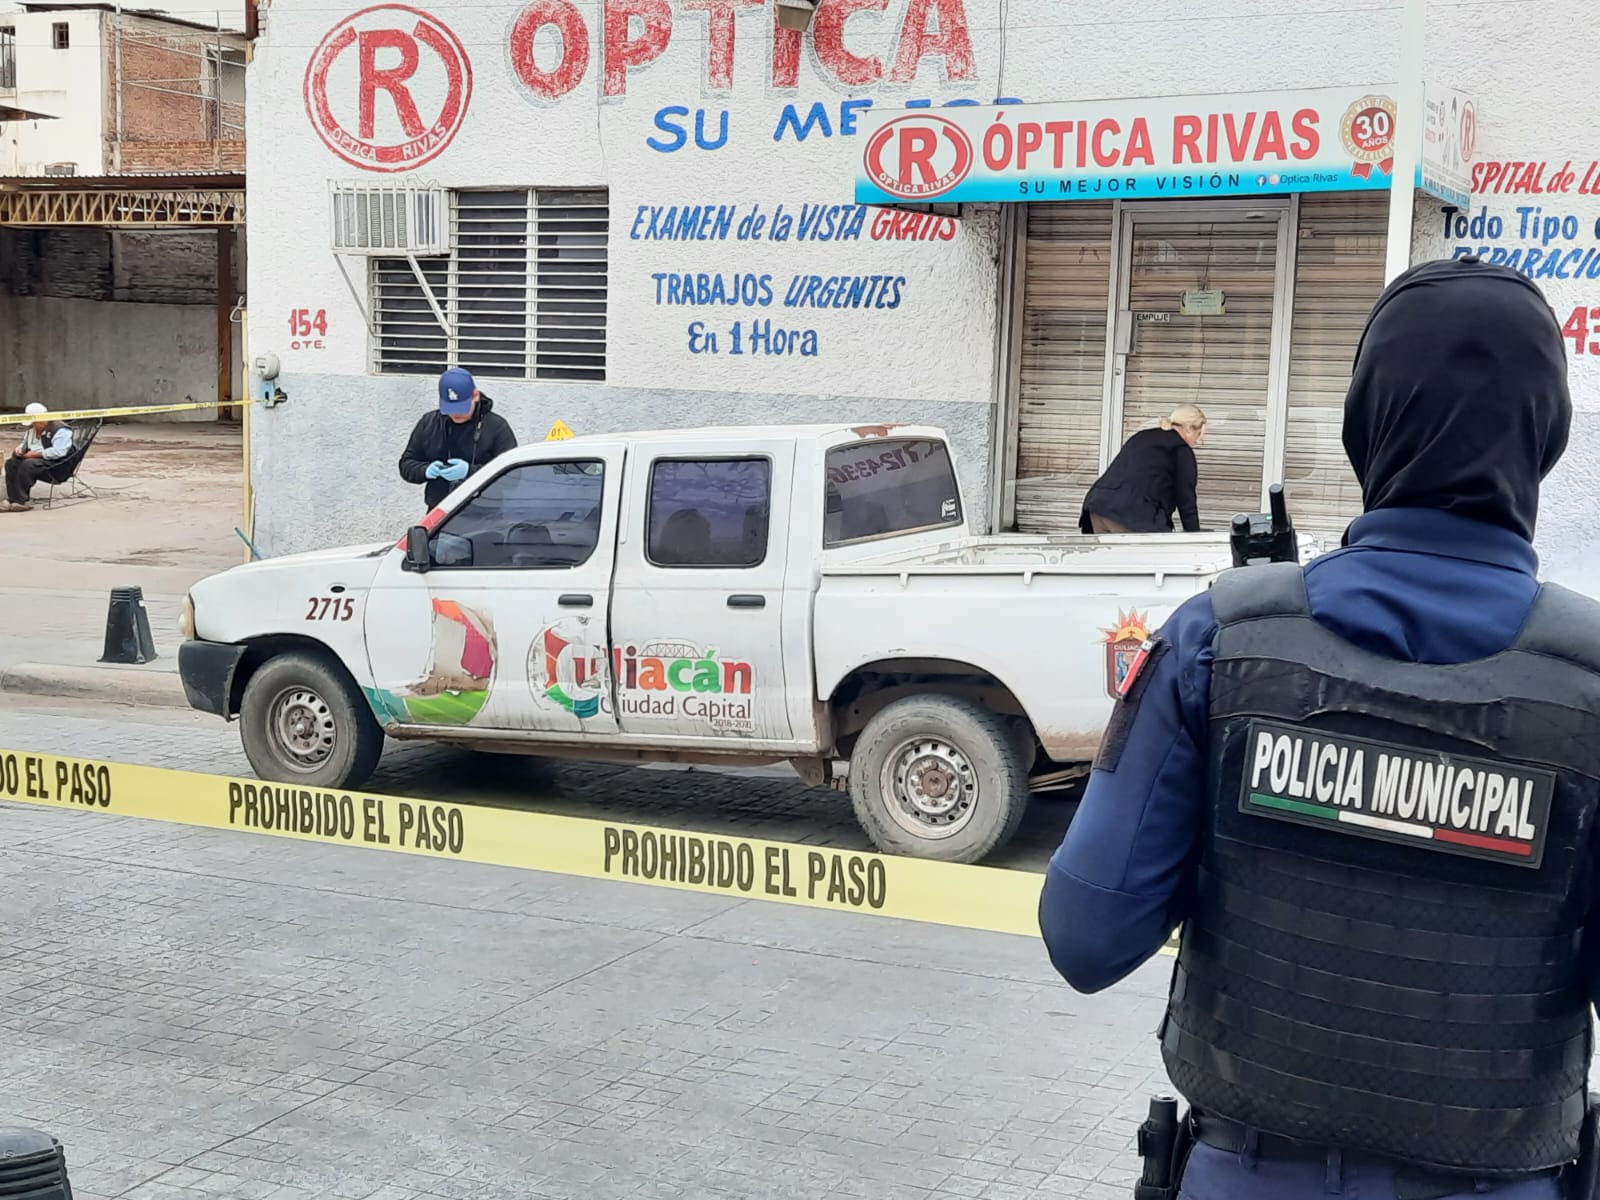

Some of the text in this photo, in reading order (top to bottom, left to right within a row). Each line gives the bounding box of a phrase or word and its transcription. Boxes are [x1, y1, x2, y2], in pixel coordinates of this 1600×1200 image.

[509, 0, 973, 98] OPTICA
[331, 121, 447, 161] OPTICA RIVAS
[647, 105, 729, 153] SU
[983, 111, 1155, 171] ÓPTICA
[1172, 108, 1321, 164] RIVAS
[1356, 111, 1390, 139] 30
[879, 171, 957, 193] OPTICA RIVAS
[1019, 172, 1240, 194] SU MEJOR VISIÓN
[1546, 160, 1576, 193] de
[630, 206, 735, 240] EXAMEN
[737, 204, 764, 240] de
[768, 204, 791, 241] la
[797, 204, 867, 240] VISTA
[1441, 206, 1503, 239] Todo
[1516, 207, 1579, 246] Tipo
[652, 273, 906, 309] TRABAJOS URGENTES
[288, 309, 328, 336] 154
[1136, 313, 1169, 321] EMPUJE
[291, 340, 326, 350] OTE.
[687, 318, 818, 356] En 1 Hora
[305, 597, 355, 621] 2715
[600, 694, 751, 722] Ciudad Capital
[26, 757, 49, 799] EL
[56, 760, 111, 808] PASO
[1251, 731, 1535, 840] POLICIA MUNICIPAL
[229, 782, 464, 854] PROHIBIDO EL PASO
[604, 827, 886, 909] PROHIBIDO EL PASO
